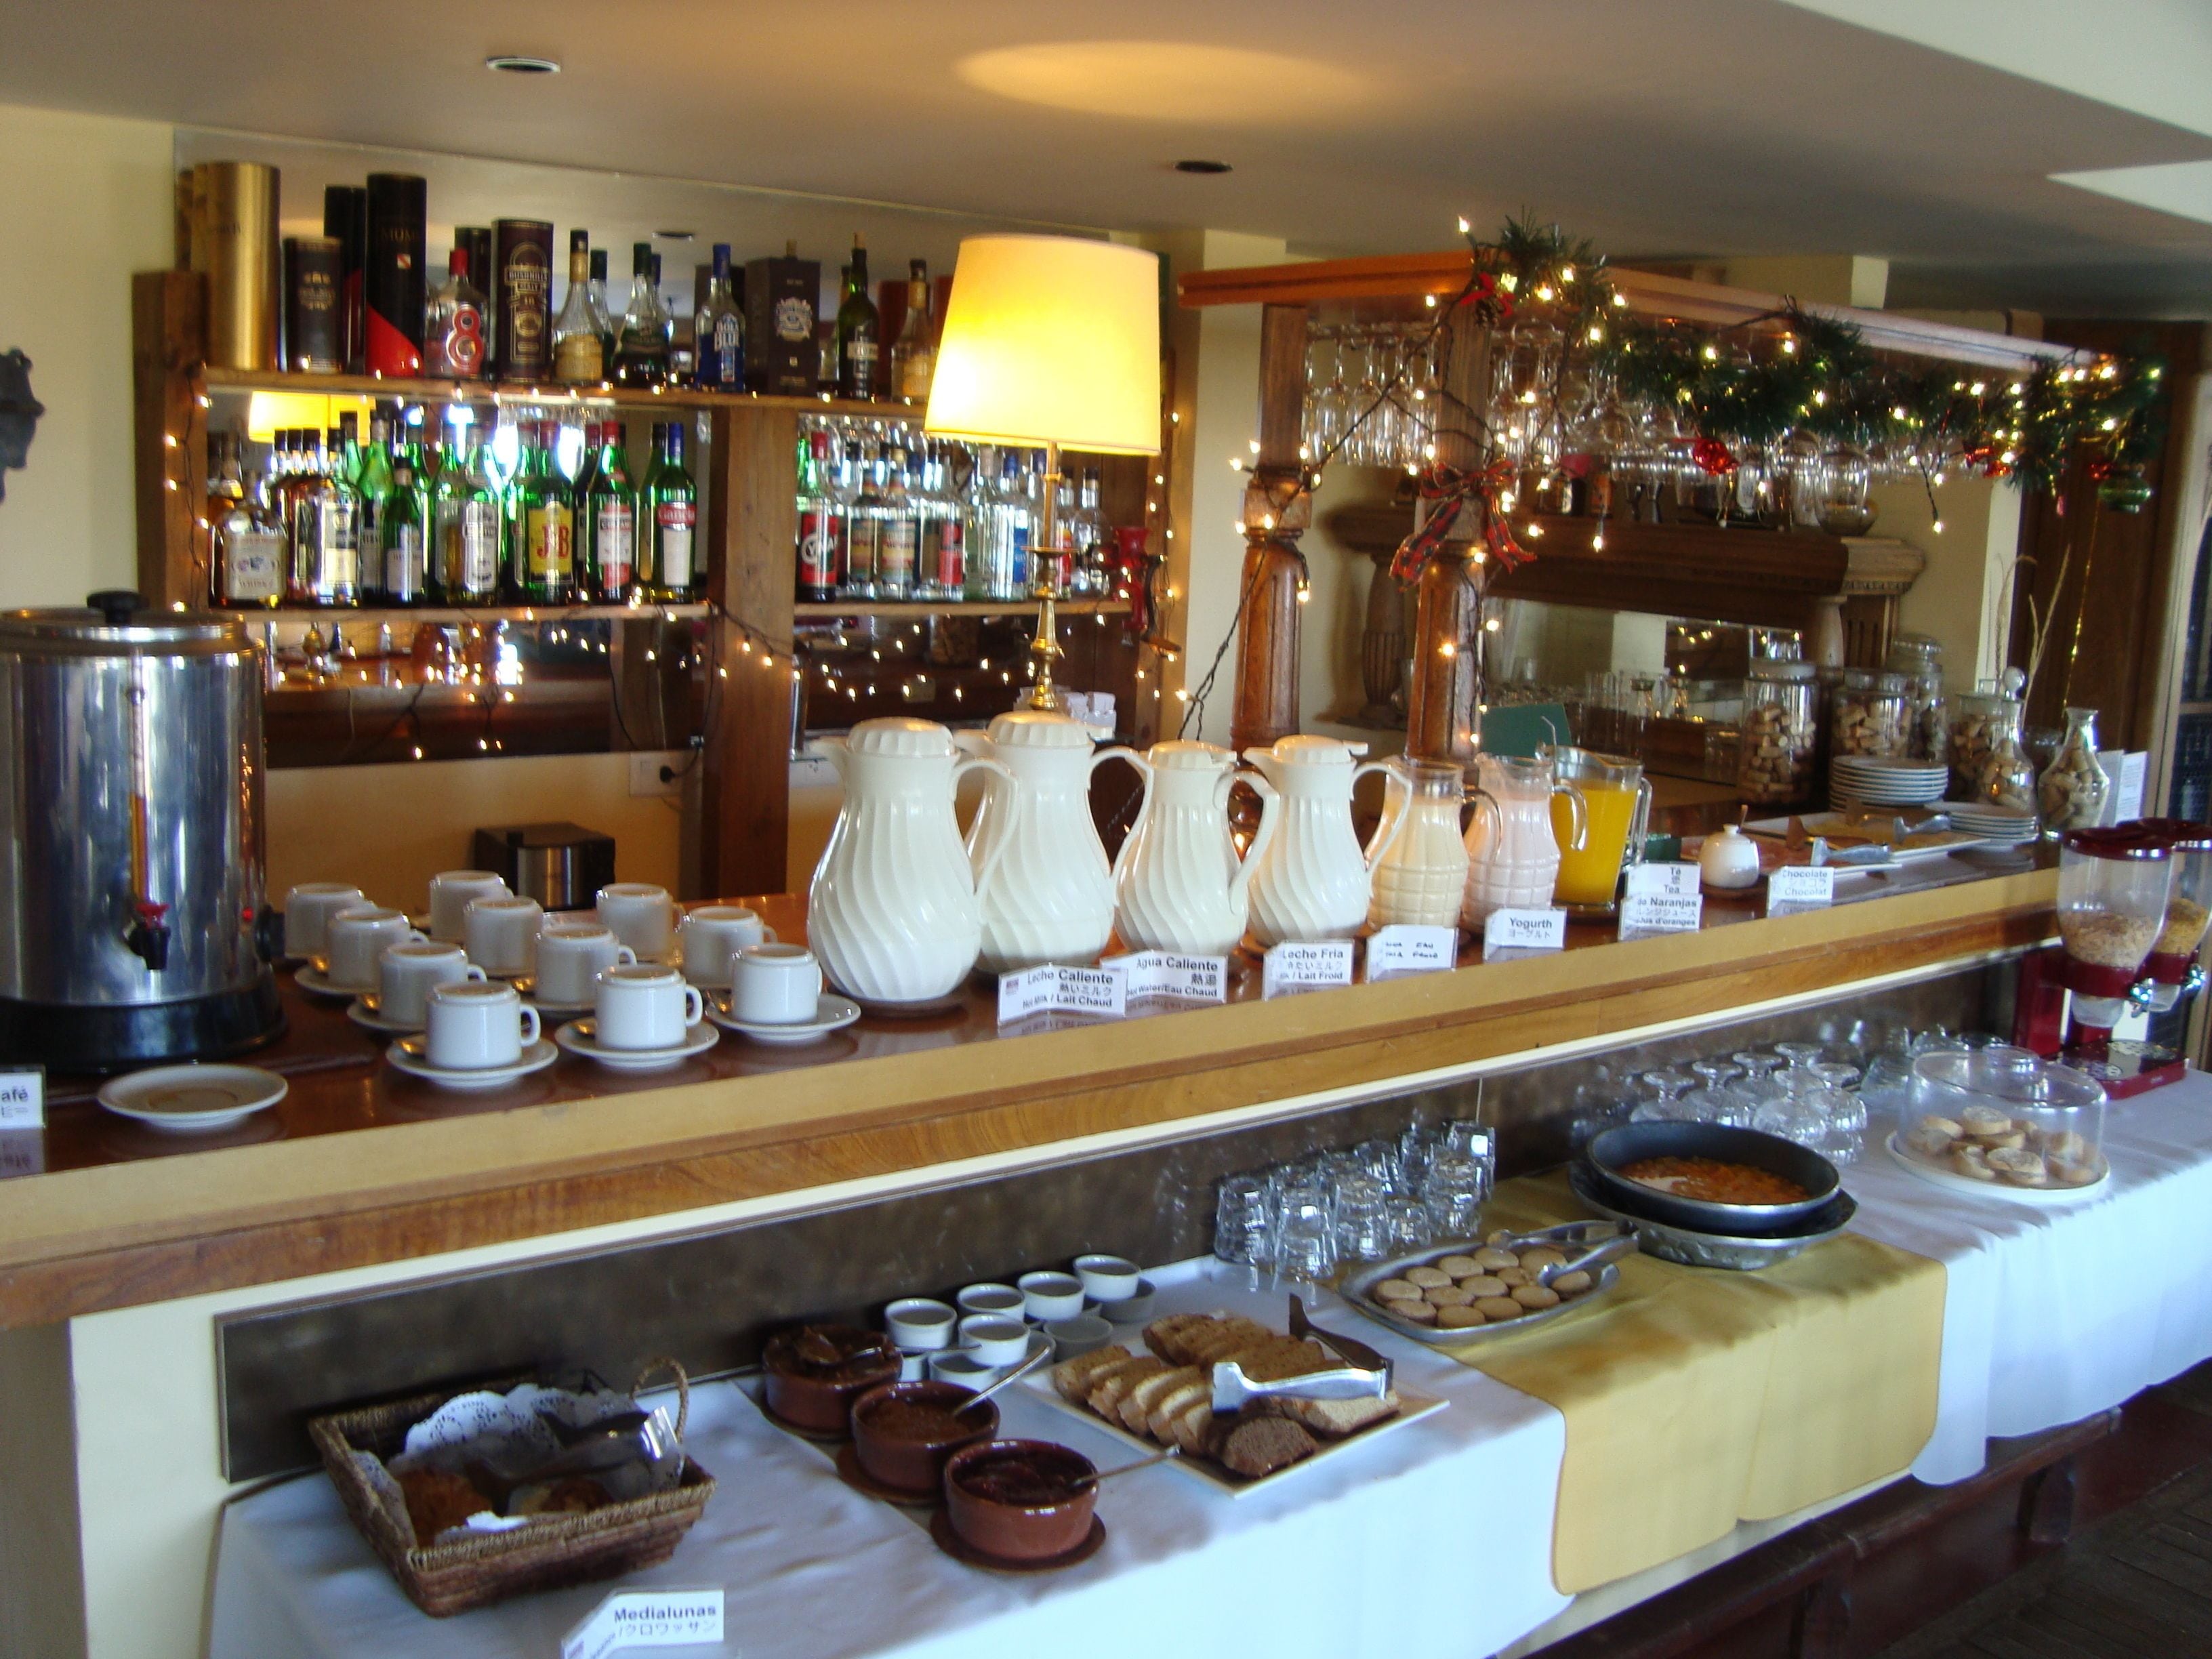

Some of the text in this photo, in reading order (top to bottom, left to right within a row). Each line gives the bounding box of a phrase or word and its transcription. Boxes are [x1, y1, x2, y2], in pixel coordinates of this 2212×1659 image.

[1782, 869, 1828, 878] Chocolate
[1664, 884, 1680, 893] Tea
[1784, 887, 1827, 896] Chocolat
[1650, 897, 1697, 908] Naranjas
[1509, 917, 1553, 930] Yogurth
[1321, 948, 1344, 959] Fria
[1136, 956, 1218, 972] Agua Caliente
[1027, 968, 1113, 985] Leche Caliente
[1298, 972, 1316, 980] Lait
[1318, 972, 1343, 980] Froid
[1185, 985, 1218, 998] Chaud
[1057, 994, 1076, 1005] Lait
[1078, 995, 1113, 1008] Chaud
[1, 1088, 29, 1103] afé
[614, 1605, 717, 1623] Medialunas
